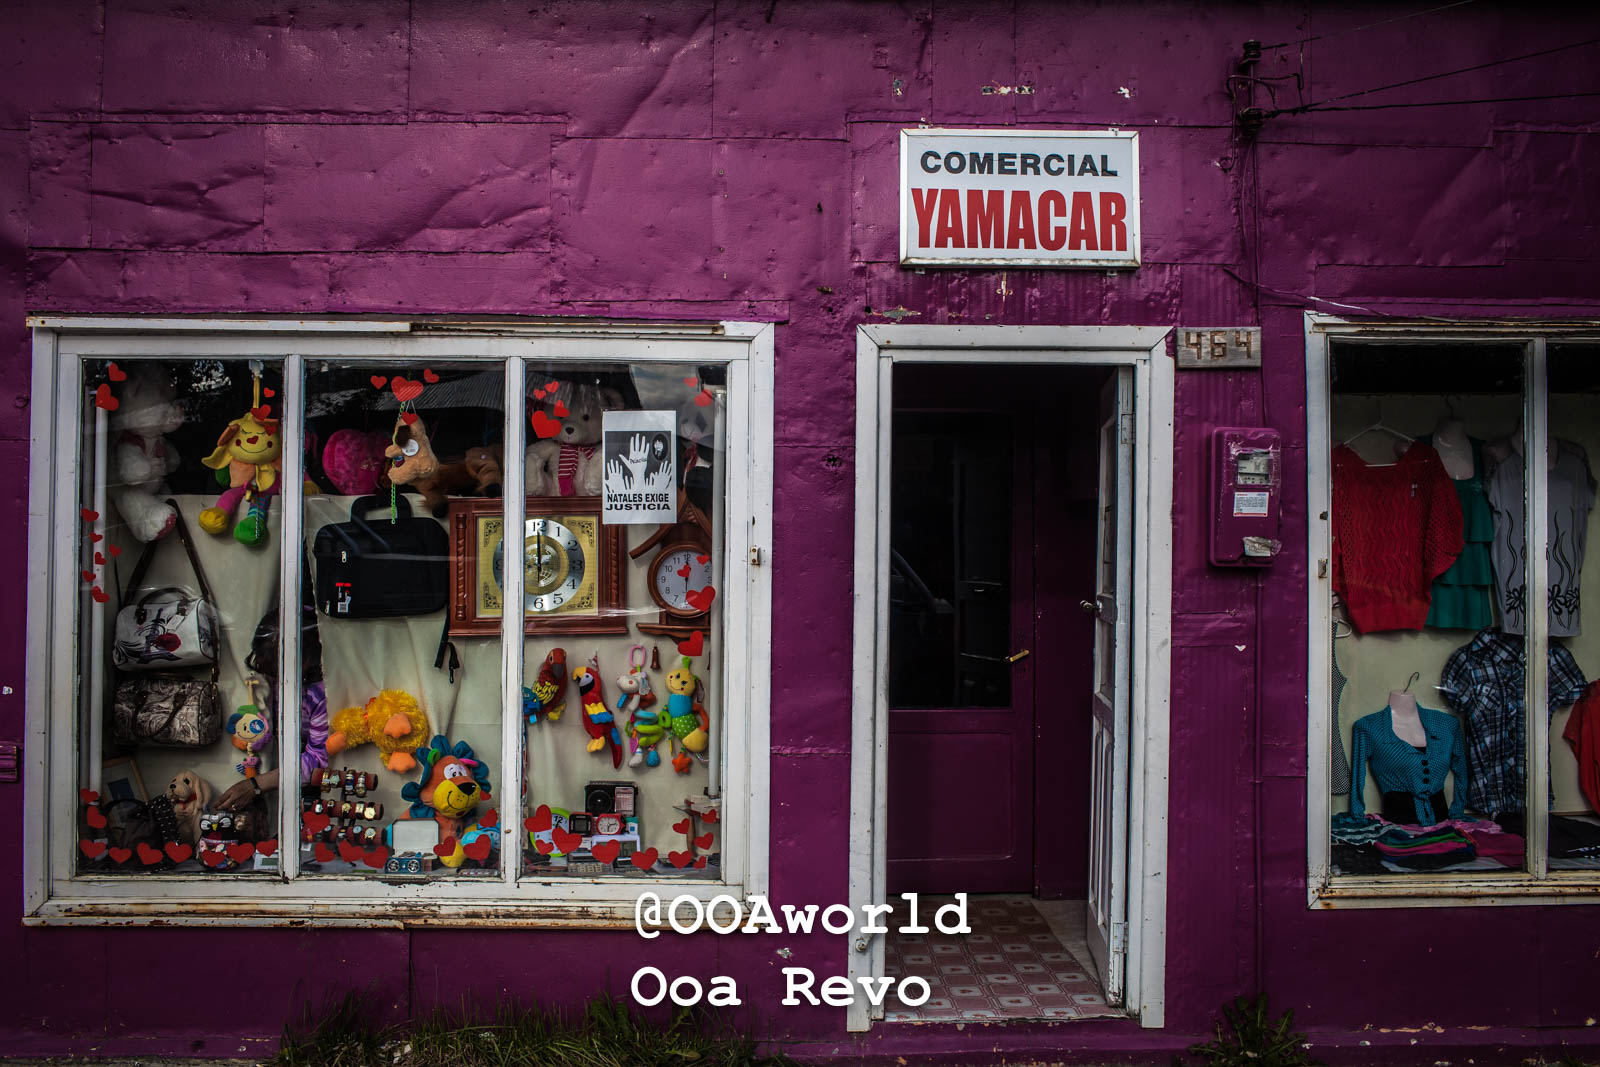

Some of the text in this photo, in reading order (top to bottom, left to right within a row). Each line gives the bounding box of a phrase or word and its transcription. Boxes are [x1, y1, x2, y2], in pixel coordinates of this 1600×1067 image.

[920, 150, 1118, 177] COMERCIAL
[911, 187, 1128, 251] YAMACAR
[1185, 331, 1252, 360] 464
[607, 493, 670, 503] NATALES EXIGE
[605, 503, 671, 511] JUSTICIA
[567, 540, 578, 551] 2
[572, 560, 583, 570] 3
[665, 565, 673, 573] 10
[566, 579, 577, 590] 4
[534, 598, 544, 609] 6
[553, 593, 564, 604] 5
